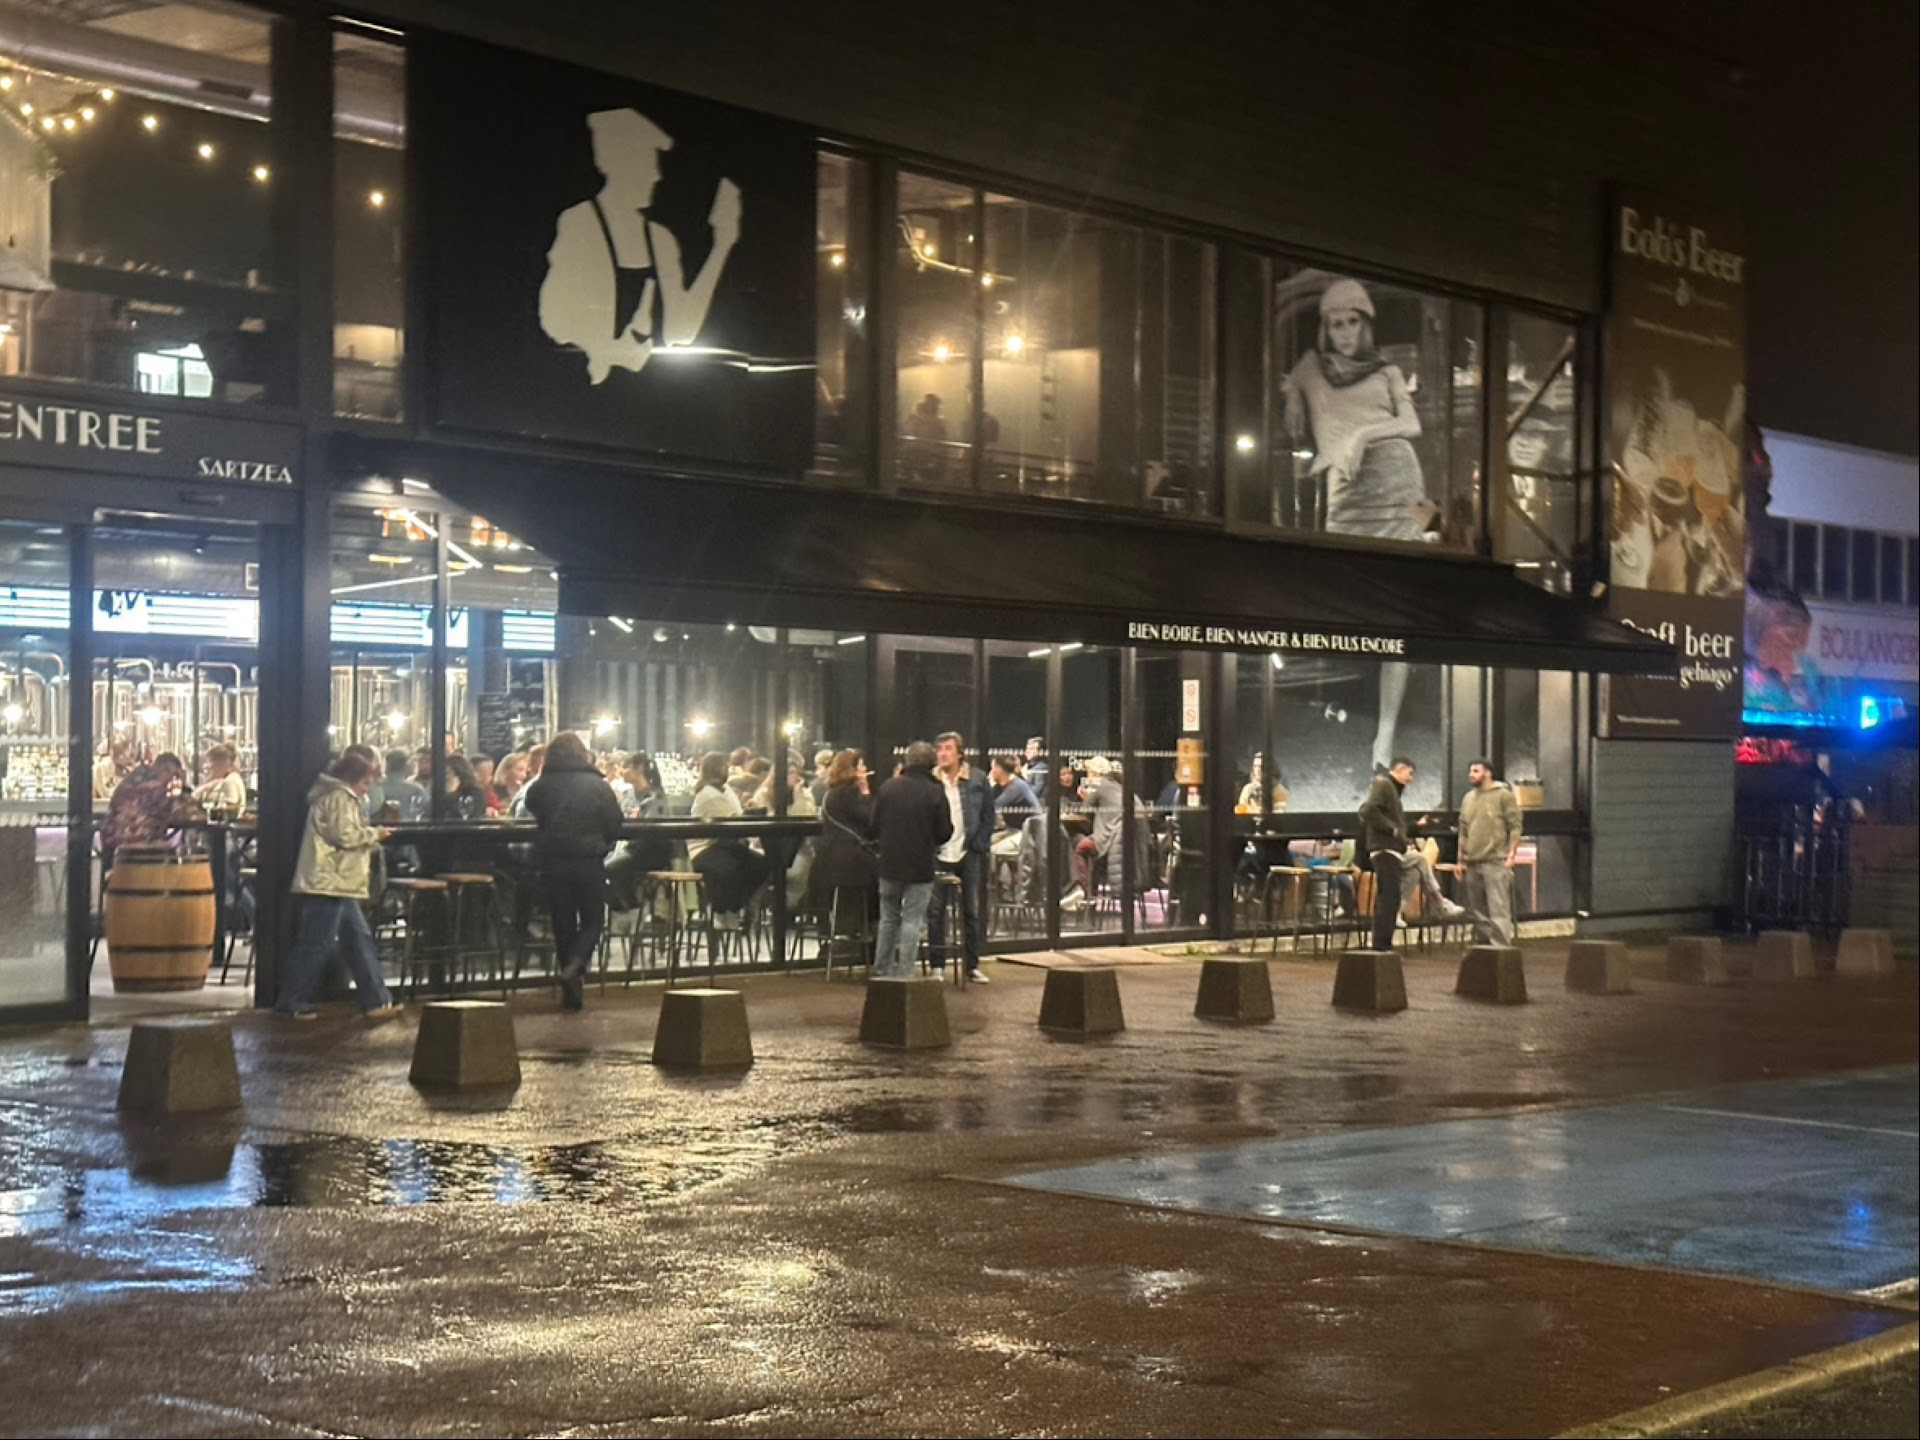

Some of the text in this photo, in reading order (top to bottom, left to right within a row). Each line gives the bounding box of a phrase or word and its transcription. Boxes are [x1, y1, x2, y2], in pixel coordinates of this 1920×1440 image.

[1689, 226, 1745, 283] Beer
[199, 457, 293, 484] SARTZEA
[1129, 622, 1405, 654] BIEN BOIRE, BIEN MANGER & BIEN PLUS ENCORE
[1685, 624, 1734, 658] beer
